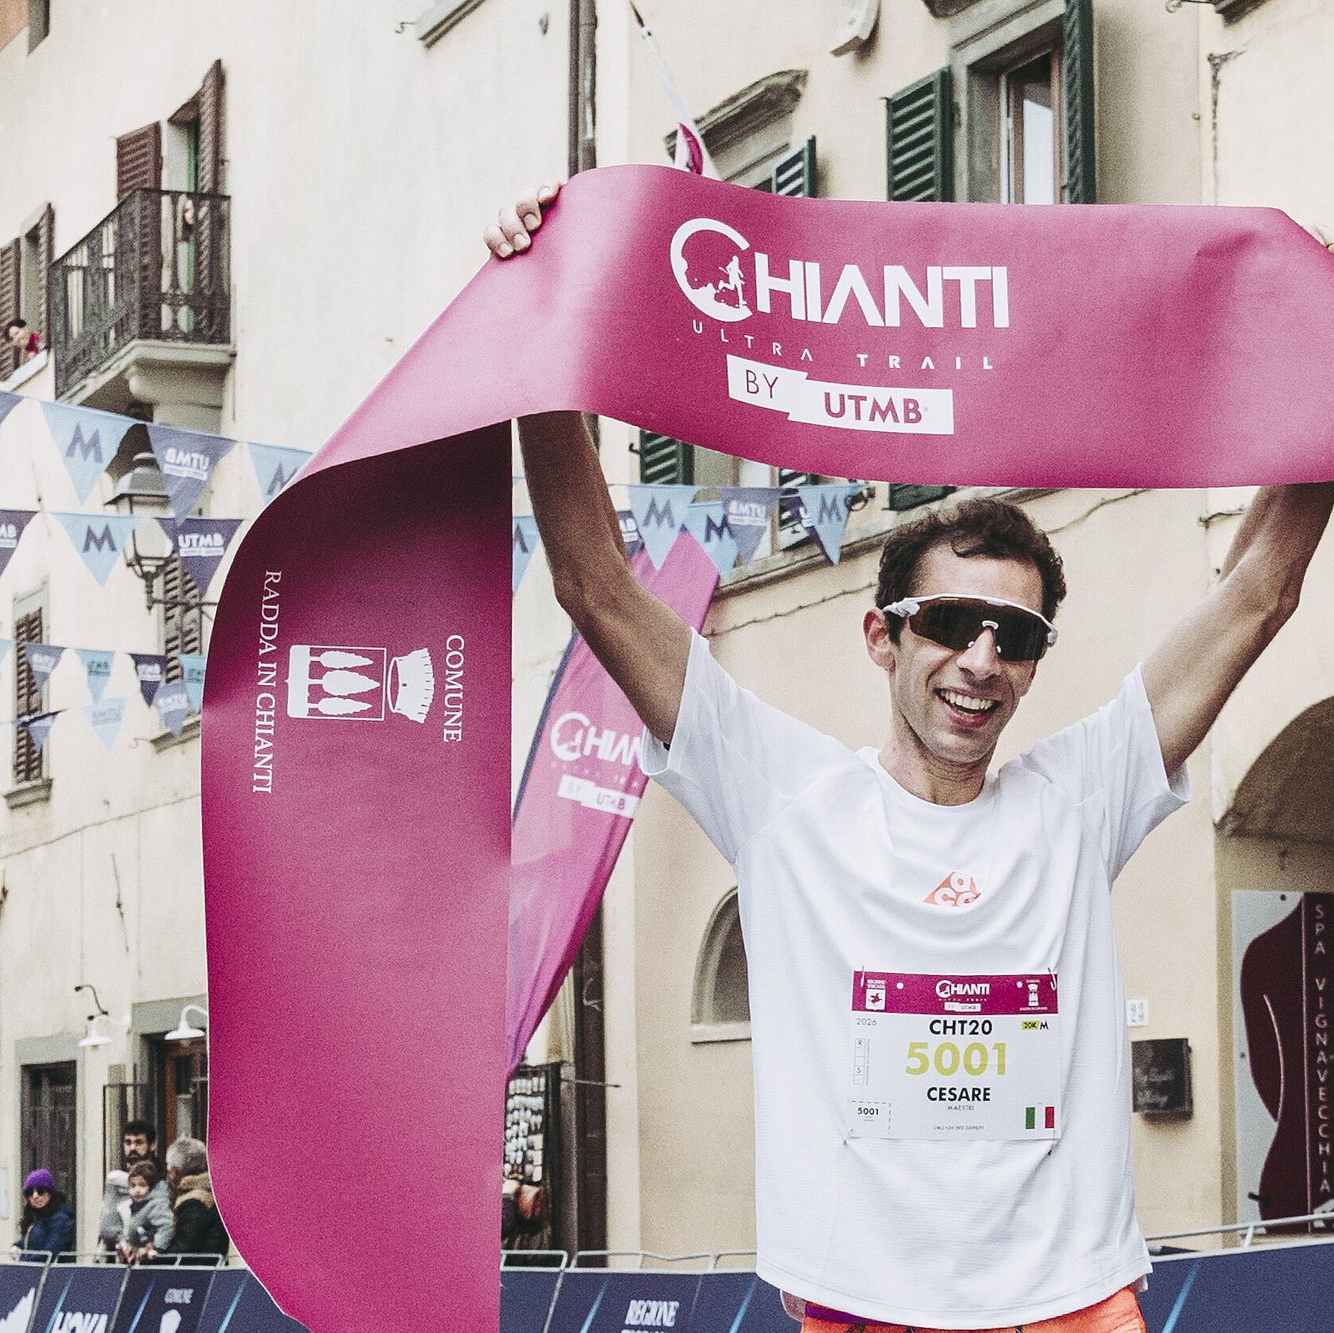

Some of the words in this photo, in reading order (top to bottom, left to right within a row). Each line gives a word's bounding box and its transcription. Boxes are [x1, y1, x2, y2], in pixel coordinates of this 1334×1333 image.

[669, 218, 1011, 328] CHIANTI
[693, 320, 814, 362] ULTRA
[857, 354, 994, 371] TRAIL
[746, 369, 778, 400] BY
[824, 391, 923, 424] UTMB
[178, 533, 225, 548] UTMB
[259, 570, 282, 656] RADDA
[258, 661, 279, 689] IN
[442, 634, 466, 744] COMUNE
[252, 691, 277, 794] CHIANTI
[550, 711, 643, 767] CHIAN
[1315, 904, 1326, 955] SPA
[929, 1019, 993, 1036] CHT20
[905, 1041, 1007, 1077] 5001
[927, 1087, 991, 1102] CESARE
[1315, 977, 1332, 1194] VIGNAVECCHIA
[857, 1107, 880, 1116] 5001
